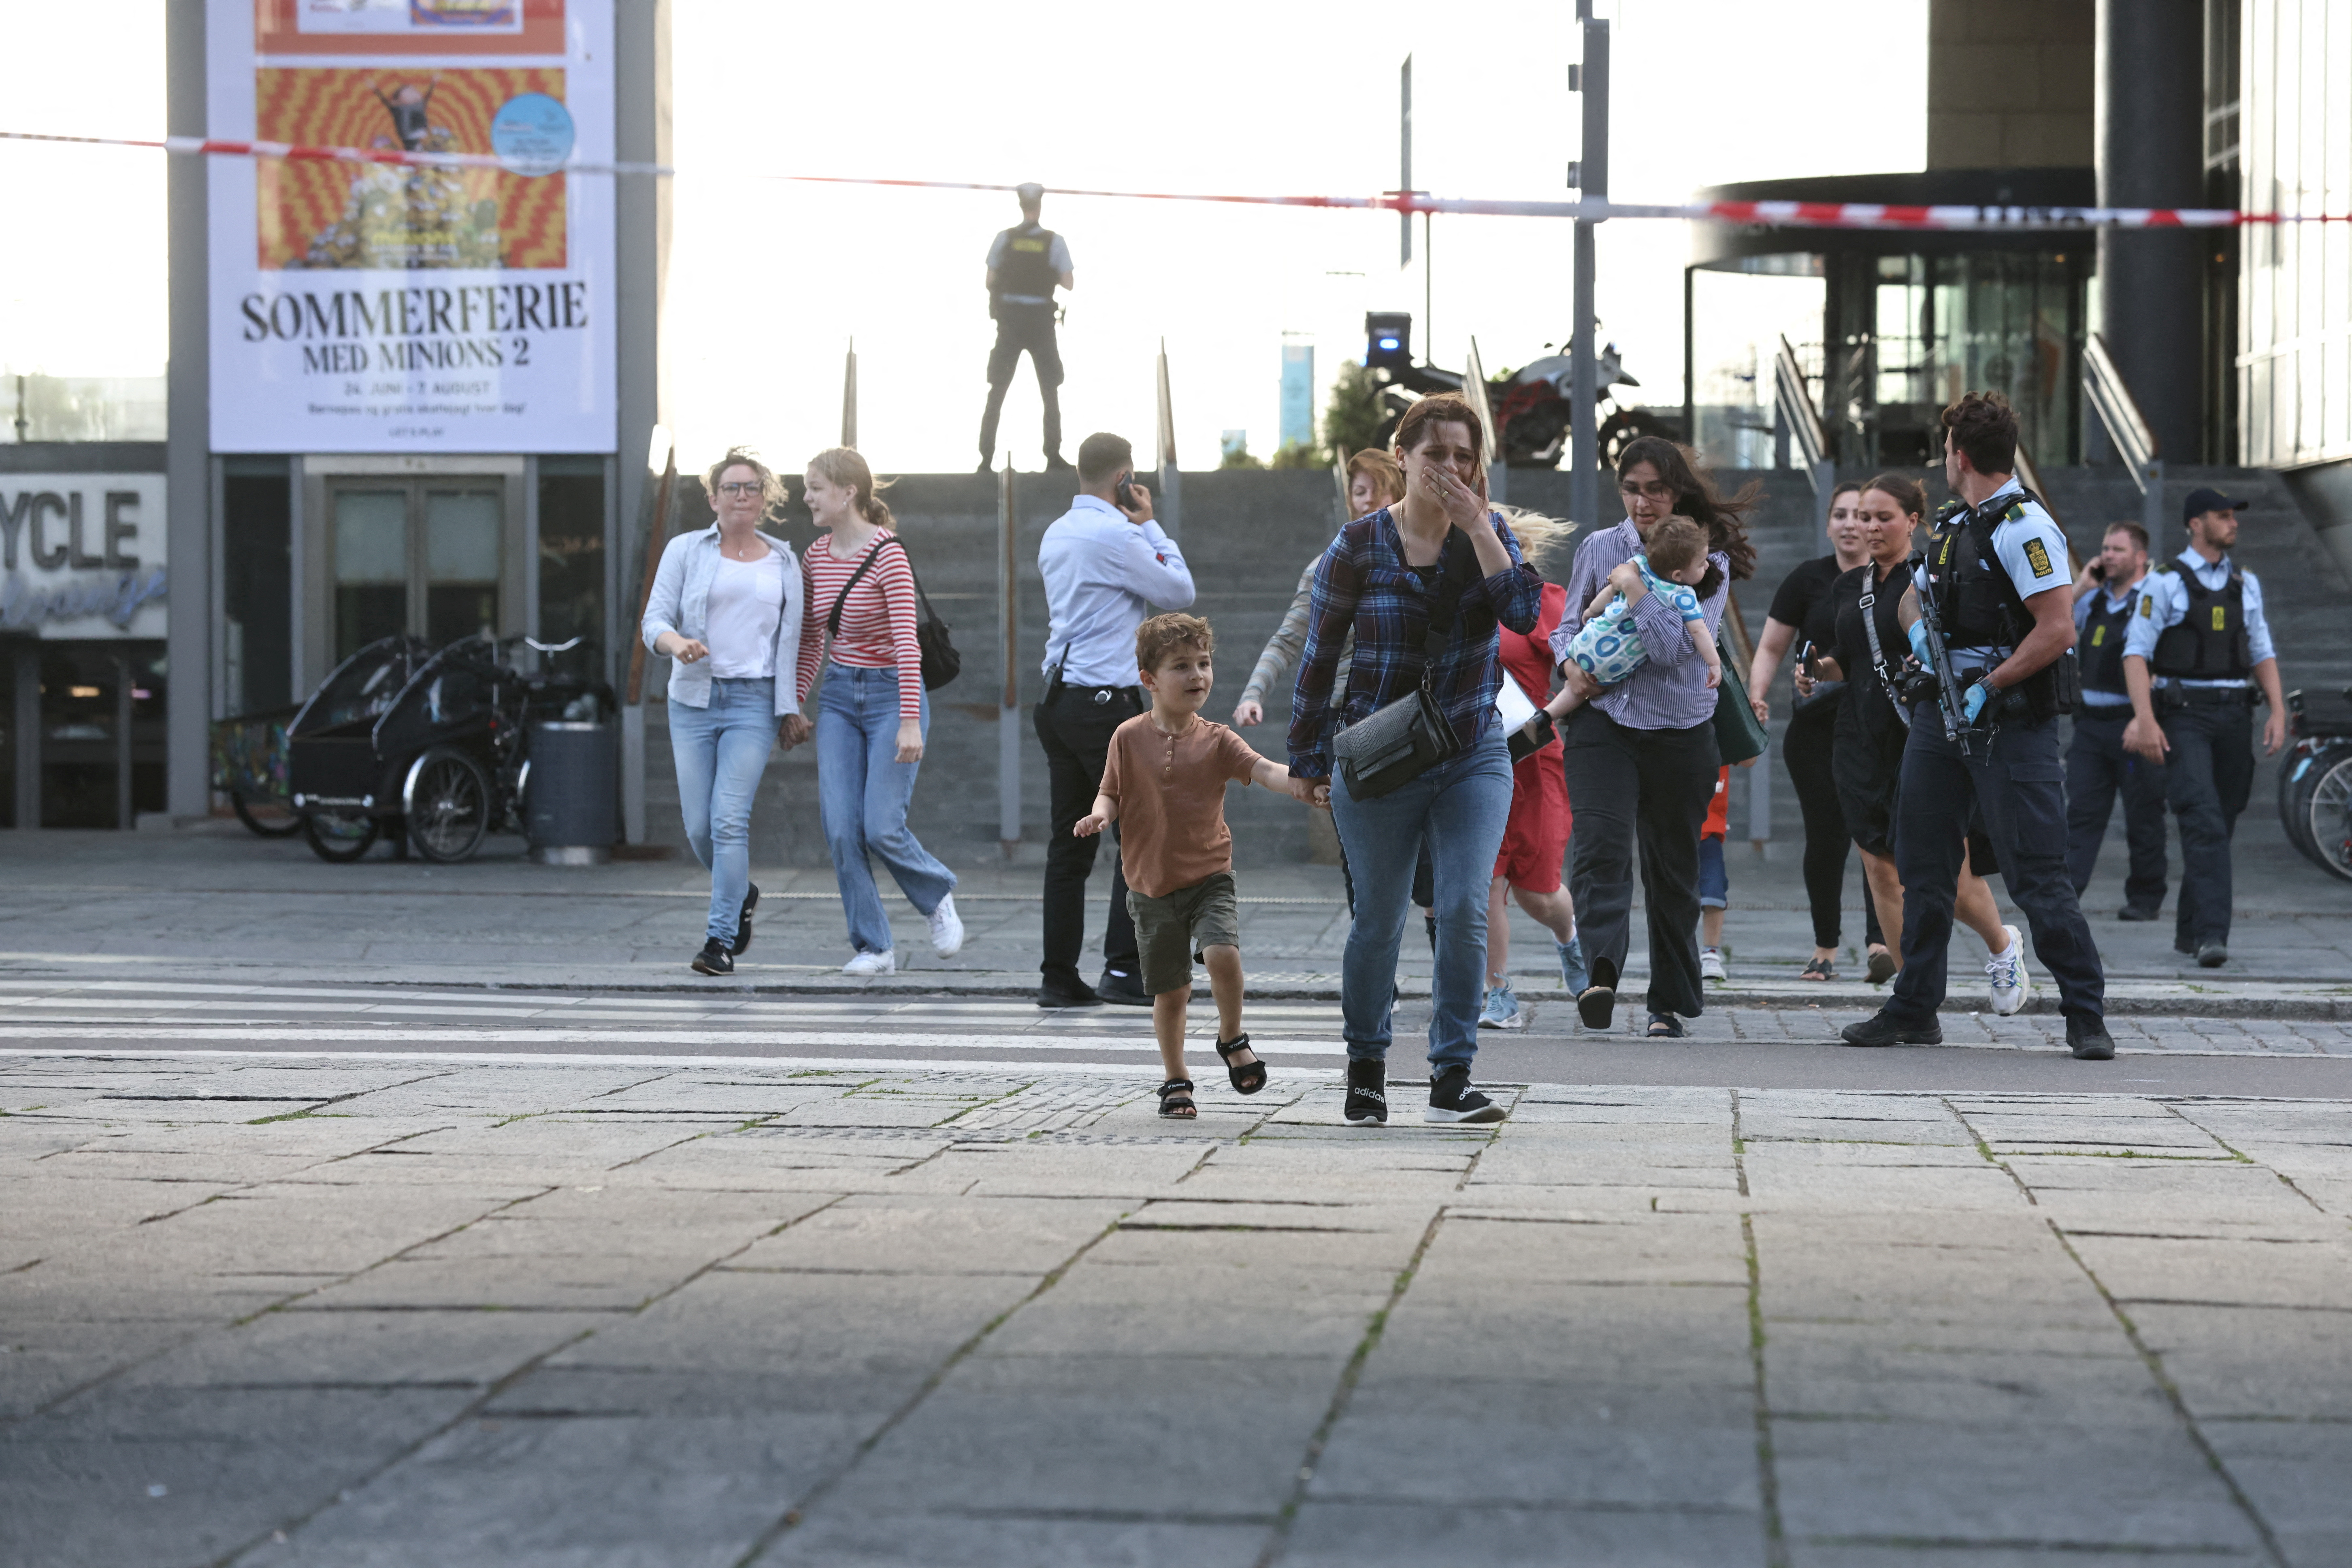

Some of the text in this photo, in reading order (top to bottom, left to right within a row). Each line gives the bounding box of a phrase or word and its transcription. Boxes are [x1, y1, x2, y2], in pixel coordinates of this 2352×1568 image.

[241, 281, 589, 343] SOMMERFERIE
[302, 337, 530, 374] MED MINIONS 2
[2036, 568, 2052, 577] POLITI
[1354, 1087, 1385, 1103] adidas
